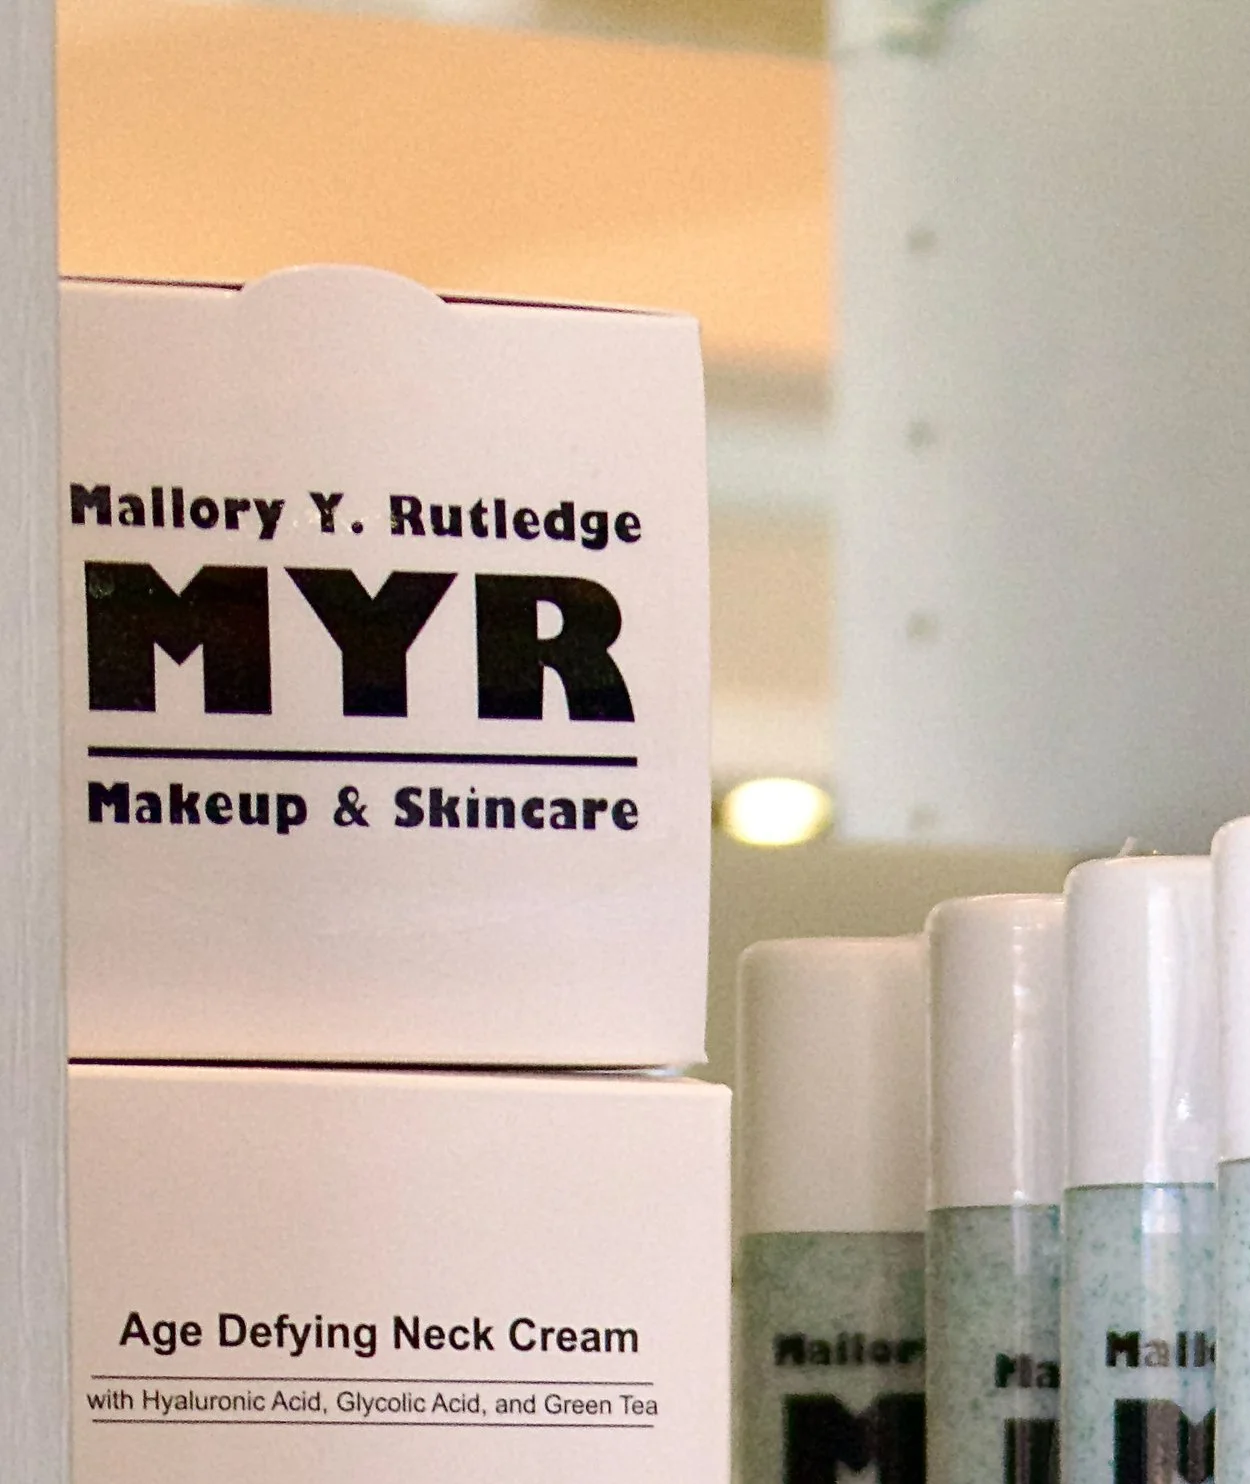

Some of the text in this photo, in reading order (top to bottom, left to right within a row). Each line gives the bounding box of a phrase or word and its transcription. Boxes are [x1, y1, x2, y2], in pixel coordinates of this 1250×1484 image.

[69, 482, 642, 551] Mallory Y. Rutledge
[83, 559, 636, 723] MYR
[87, 780, 639, 835] Makeup & Skincare
[119, 1311, 639, 1359] Age Defying Neck Cream
[86, 1388, 659, 1418] with Hyaluronic Acid, Glycolic Acid, and Green Tea
